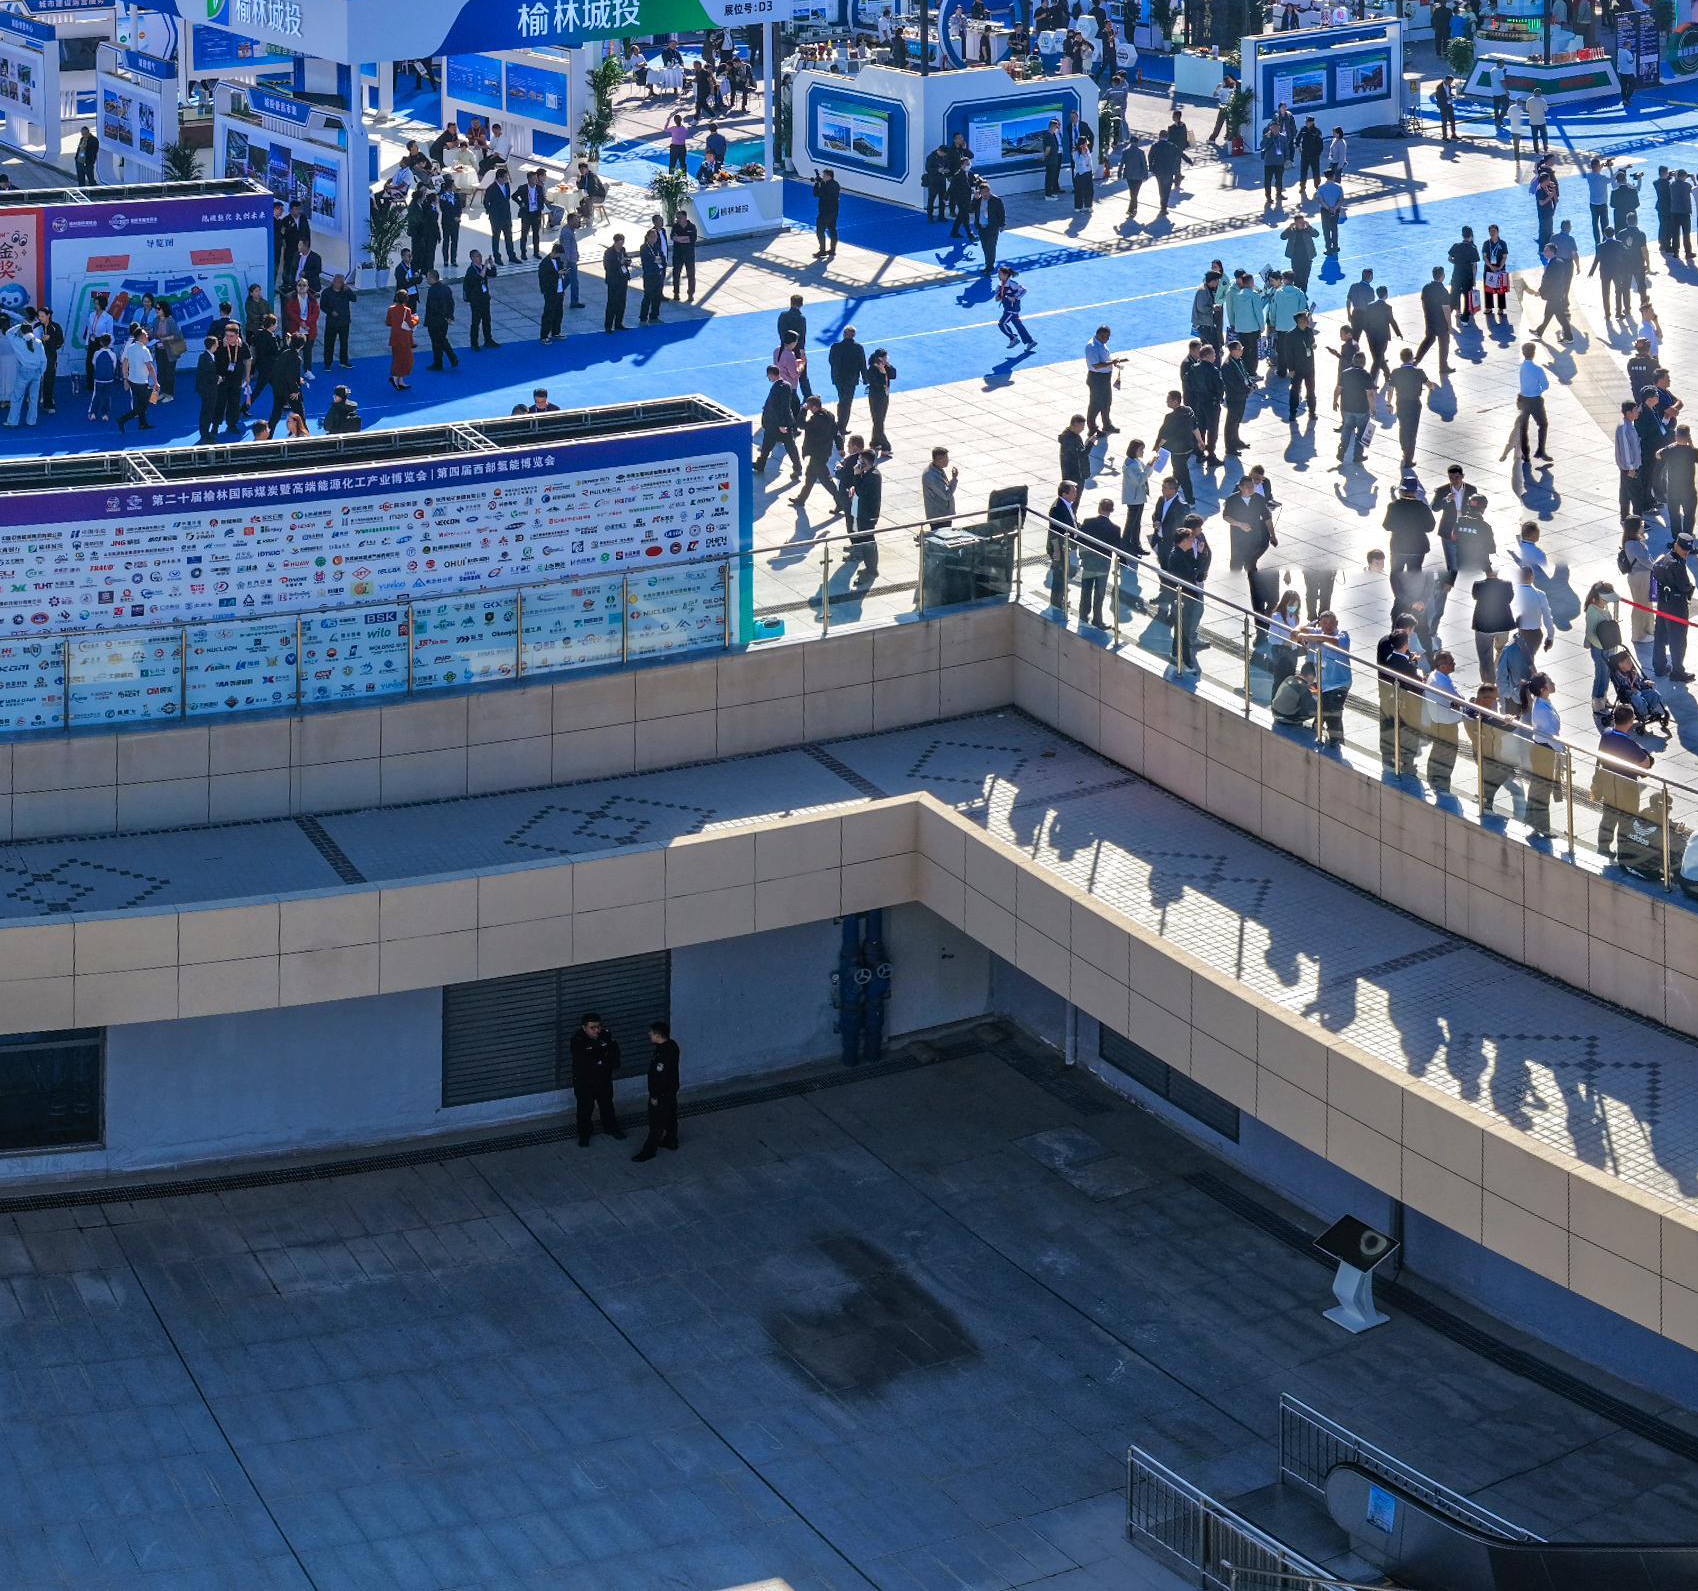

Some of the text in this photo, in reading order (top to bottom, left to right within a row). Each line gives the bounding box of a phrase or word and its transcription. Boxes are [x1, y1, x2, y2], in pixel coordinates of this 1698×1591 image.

[723, 0, 773, 17] 展位号:D3
[146, 237, 175, 248] 导览图
[151, 454, 556, 507] 第二十届榆林国际煤炭暨高端能源化工产业博览会 第四届西部氢能博览会
[366, 612, 395, 624] BSK
[367, 627, 392, 639] wilo
